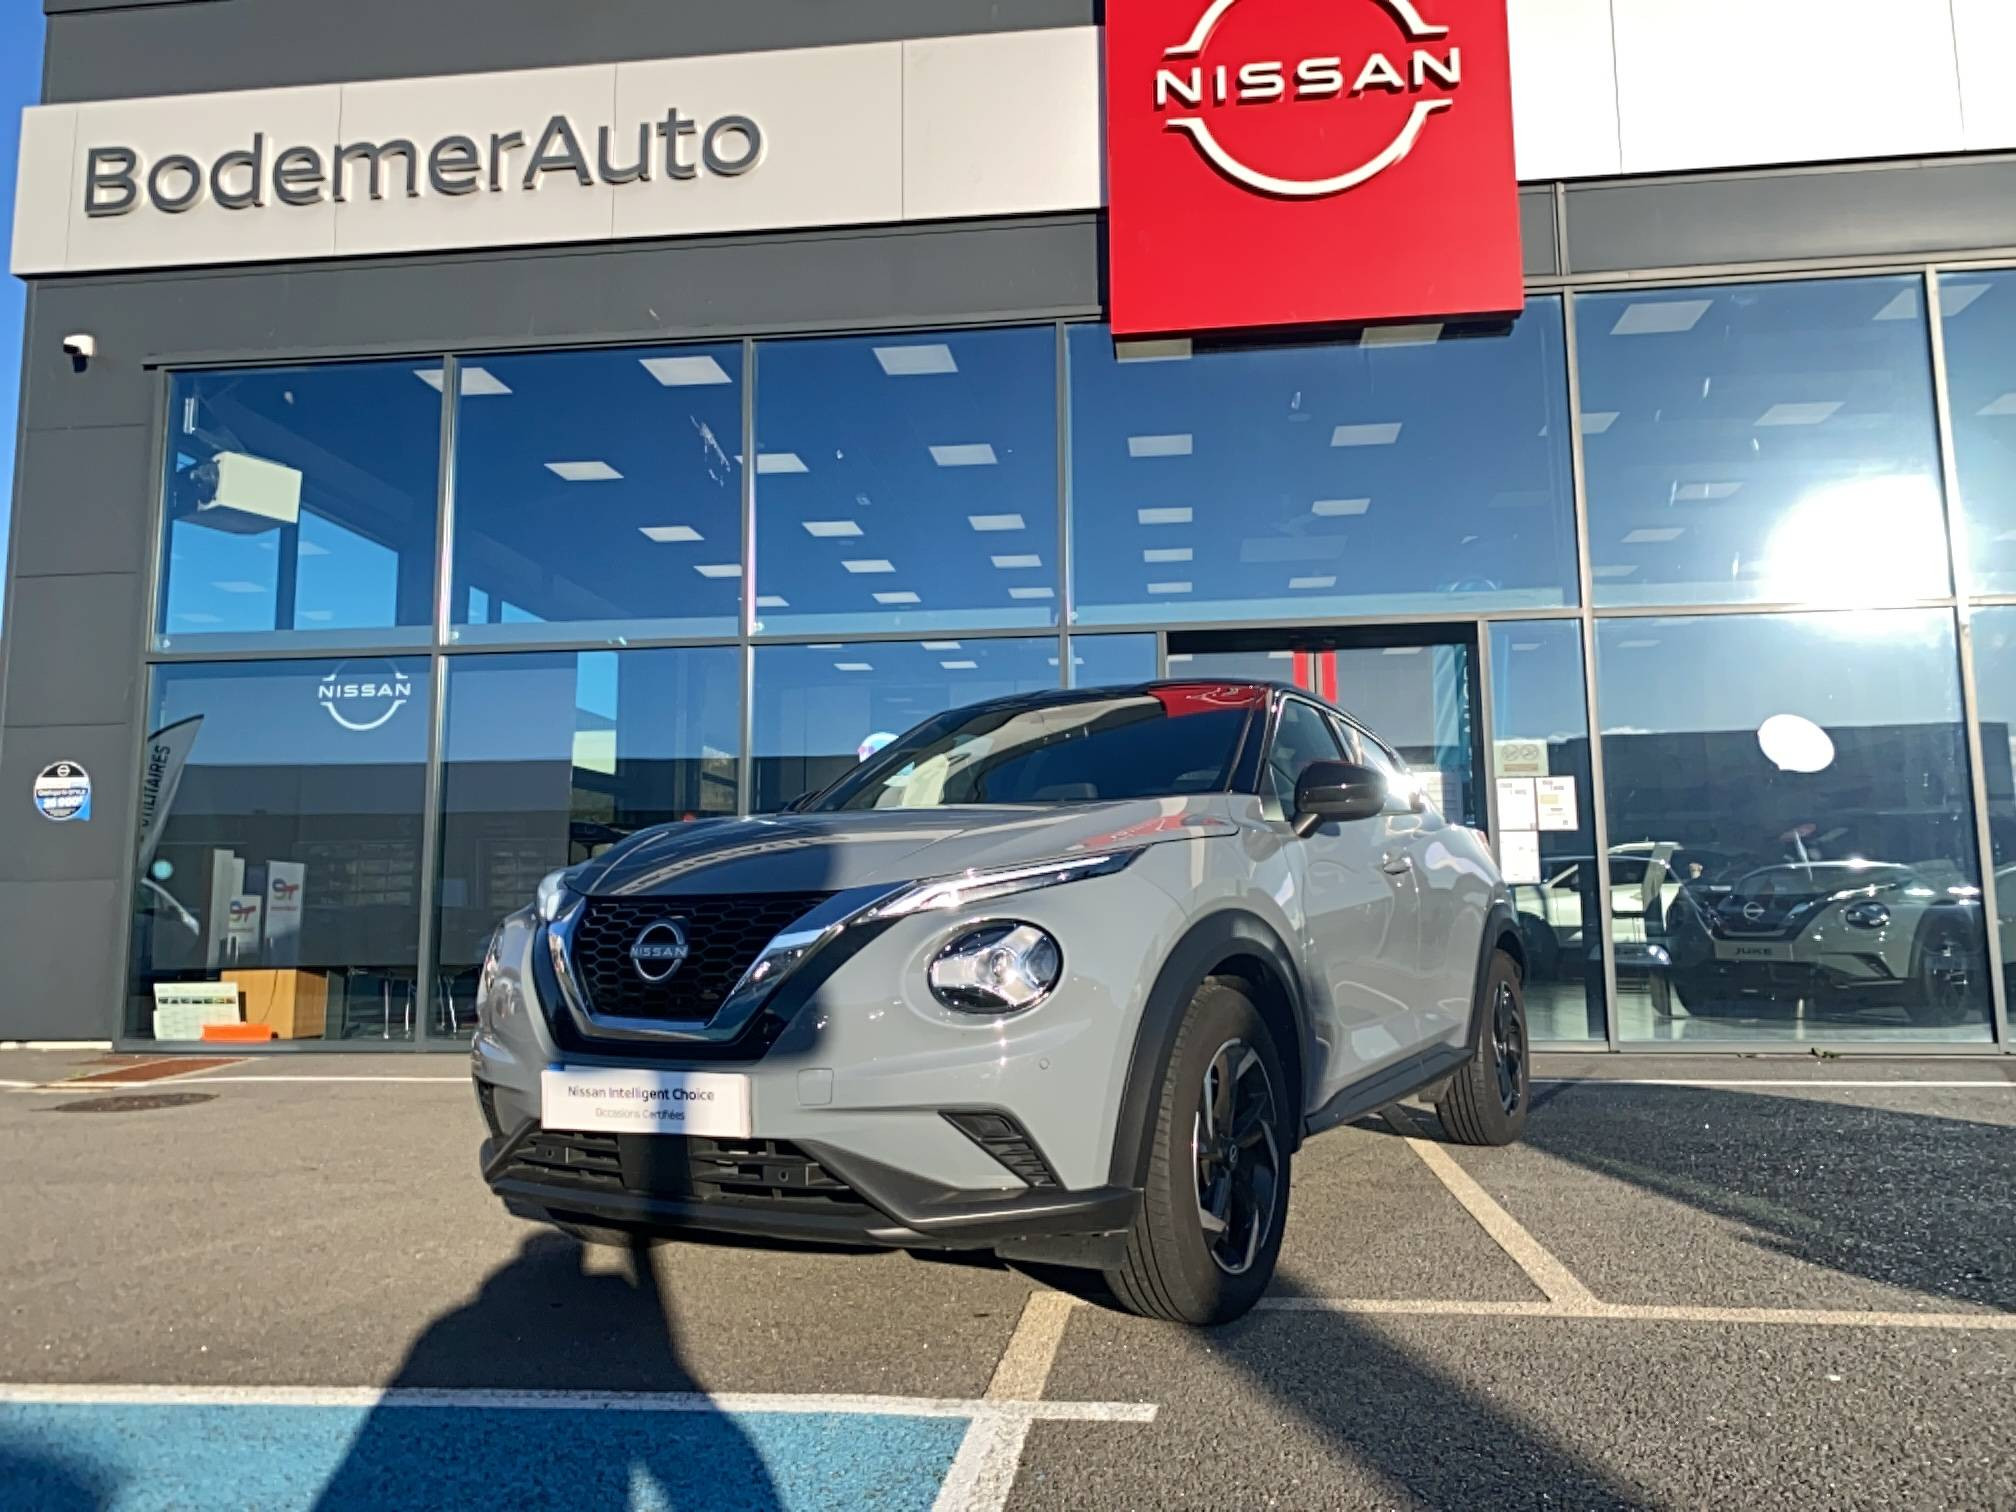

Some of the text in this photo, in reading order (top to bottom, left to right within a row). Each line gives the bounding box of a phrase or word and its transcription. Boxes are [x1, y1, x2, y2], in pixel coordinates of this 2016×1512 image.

[1155, 47, 1461, 106] NISSAN
[84, 107, 763, 218] BodemerAuto
[318, 683, 411, 699] NISSAN
[631, 946, 688, 958] NISSAN
[568, 1086, 715, 1102] Nissan Intelligent Choice
